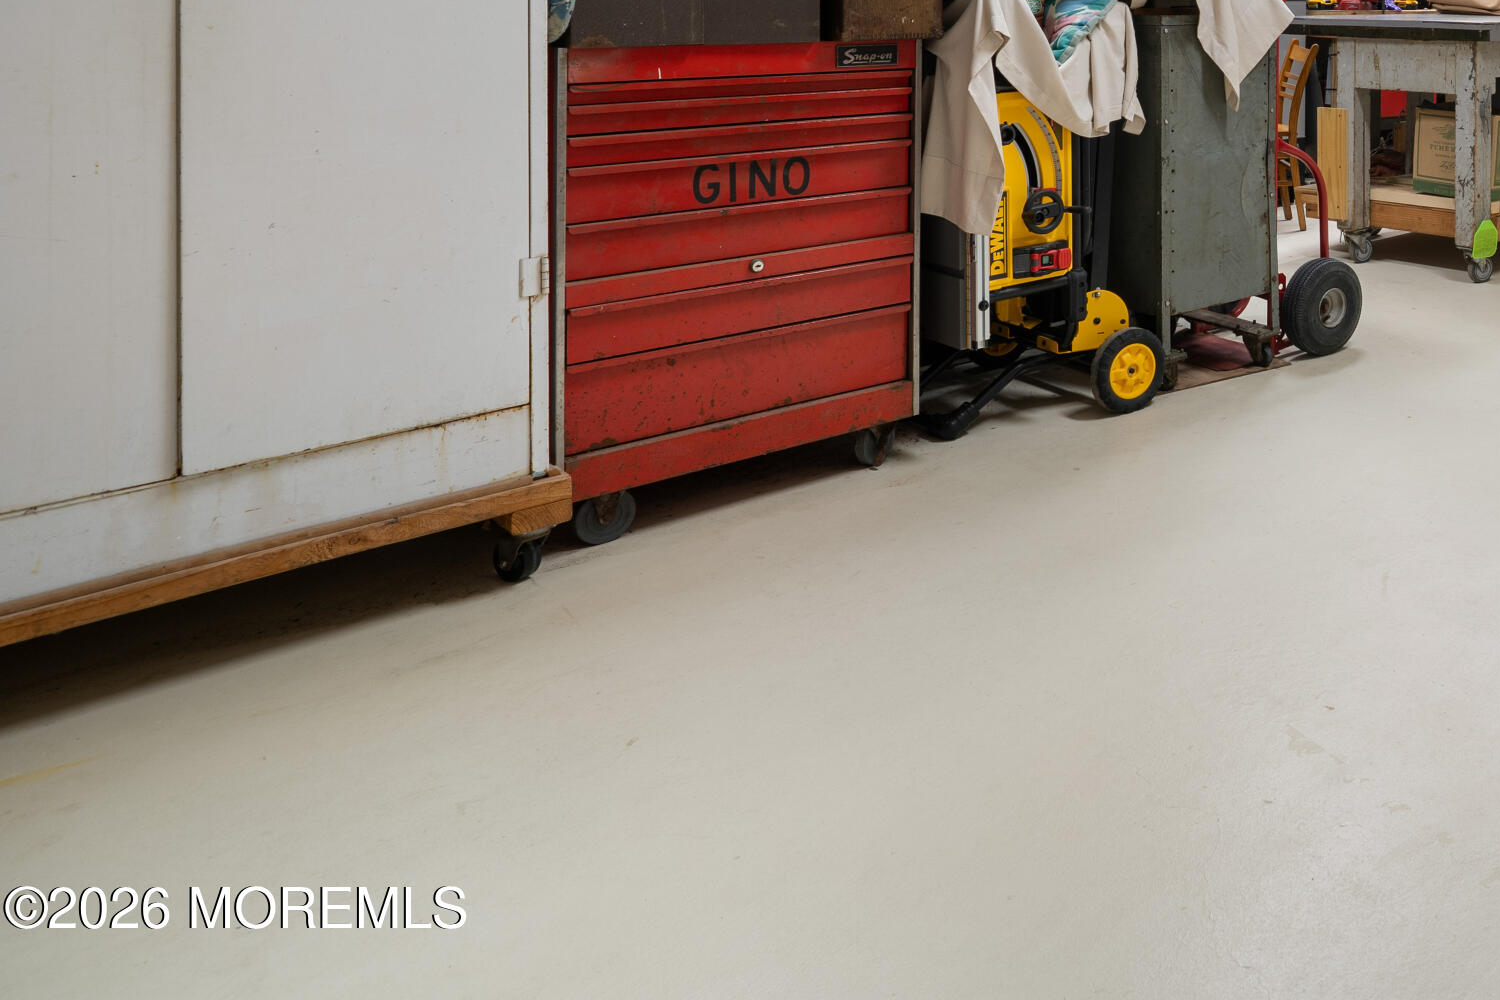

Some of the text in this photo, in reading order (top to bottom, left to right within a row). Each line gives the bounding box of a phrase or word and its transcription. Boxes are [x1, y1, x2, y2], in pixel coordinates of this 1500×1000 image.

[842, 48, 893, 64] Snap-on
[693, 156, 810, 204] GINO
[990, 200, 1005, 277] DEWA
